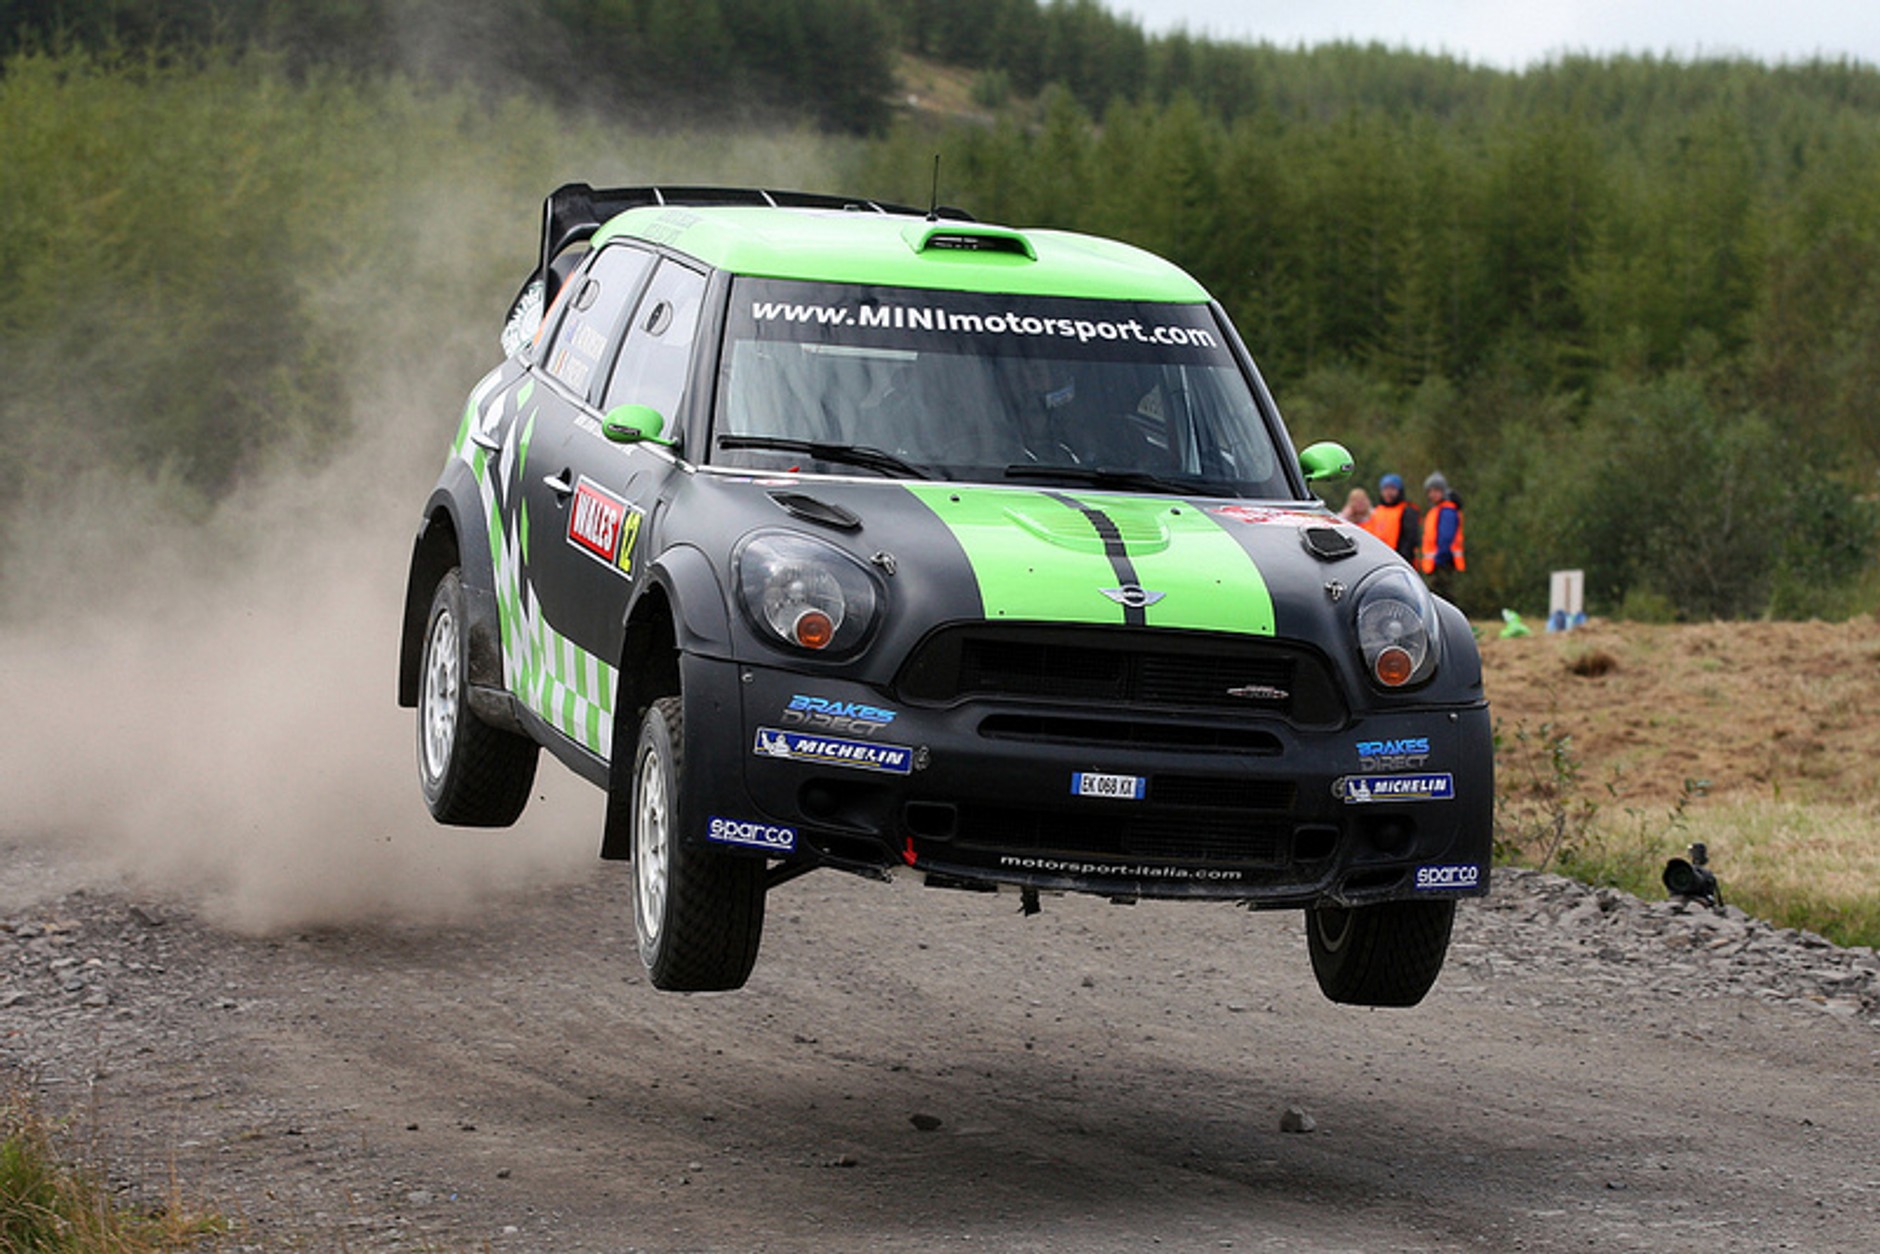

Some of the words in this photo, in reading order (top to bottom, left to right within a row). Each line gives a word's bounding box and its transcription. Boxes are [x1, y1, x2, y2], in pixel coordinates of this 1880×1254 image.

[752, 301, 1217, 348] www.MINImotorsport.com
[573, 490, 617, 552] WALES
[787, 694, 897, 723] BRAKES
[795, 739, 904, 765] MICHELIN
[1355, 737, 1430, 756] BRAKES
[1373, 778, 1447, 793] MICHELIN
[710, 818, 793, 845] sparco
[1000, 855, 1242, 880] motorsport-italia.com
[1416, 866, 1478, 883] sparco
